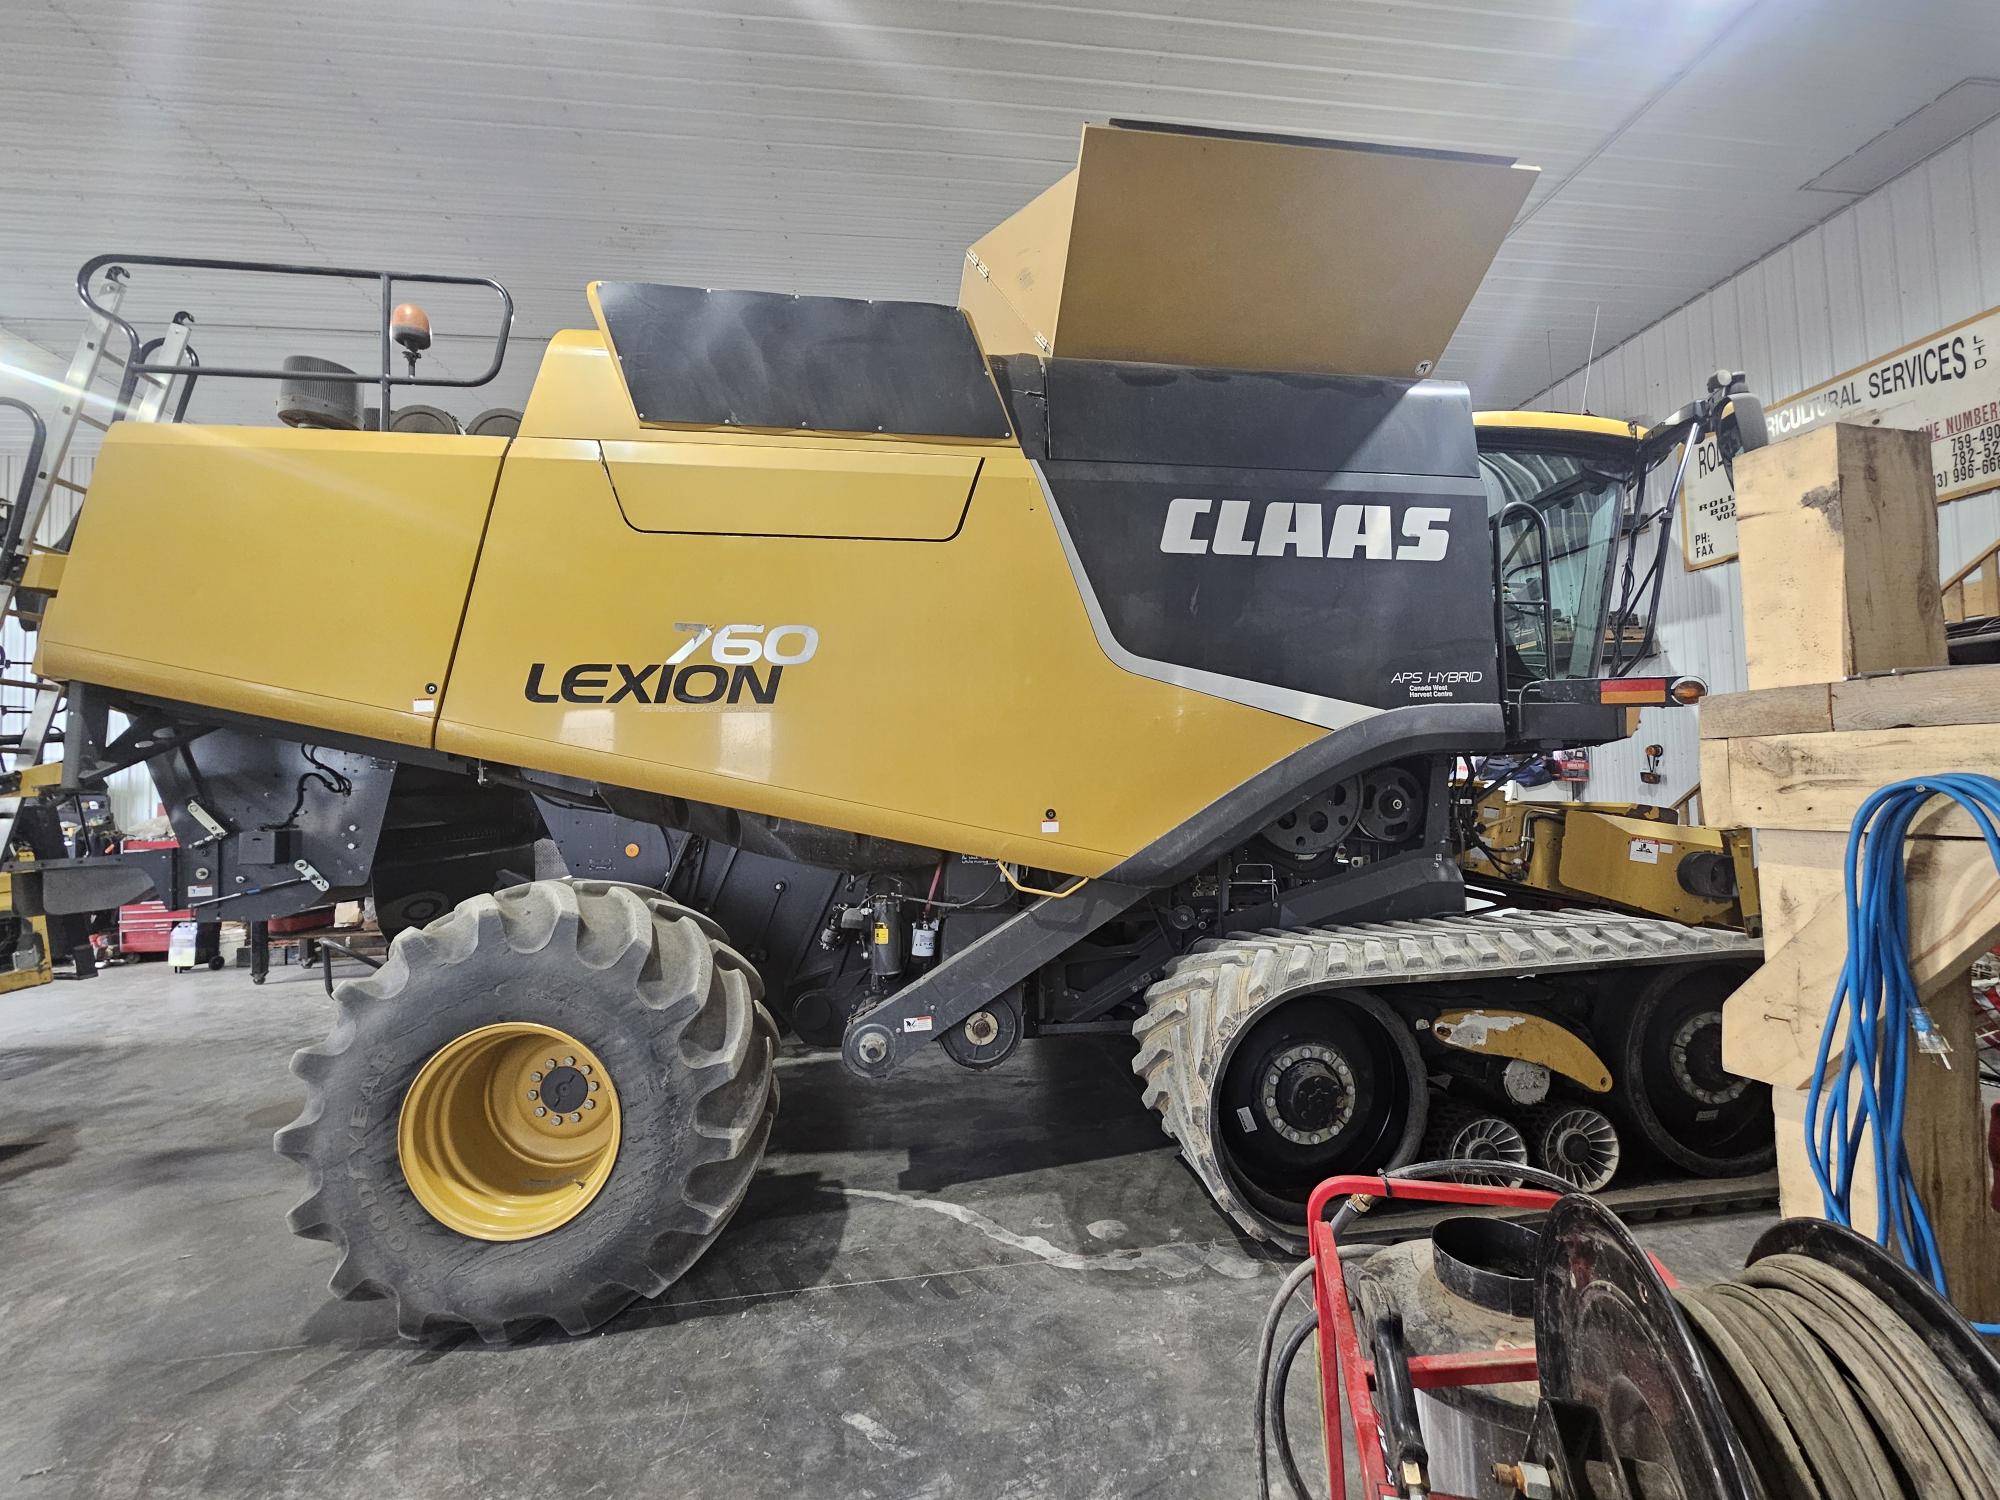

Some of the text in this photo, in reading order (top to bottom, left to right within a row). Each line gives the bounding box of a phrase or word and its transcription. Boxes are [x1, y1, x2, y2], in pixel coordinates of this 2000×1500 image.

[1868, 336, 1967, 399] SERVICES
[1945, 401, 2000, 435] NUMBER
[1160, 498, 1452, 561] CLAAS
[1696, 543, 1714, 558] FAX
[665, 622, 819, 664] 760
[524, 663, 784, 705] LEXION
[1390, 671, 1483, 683] APS HYBRID
